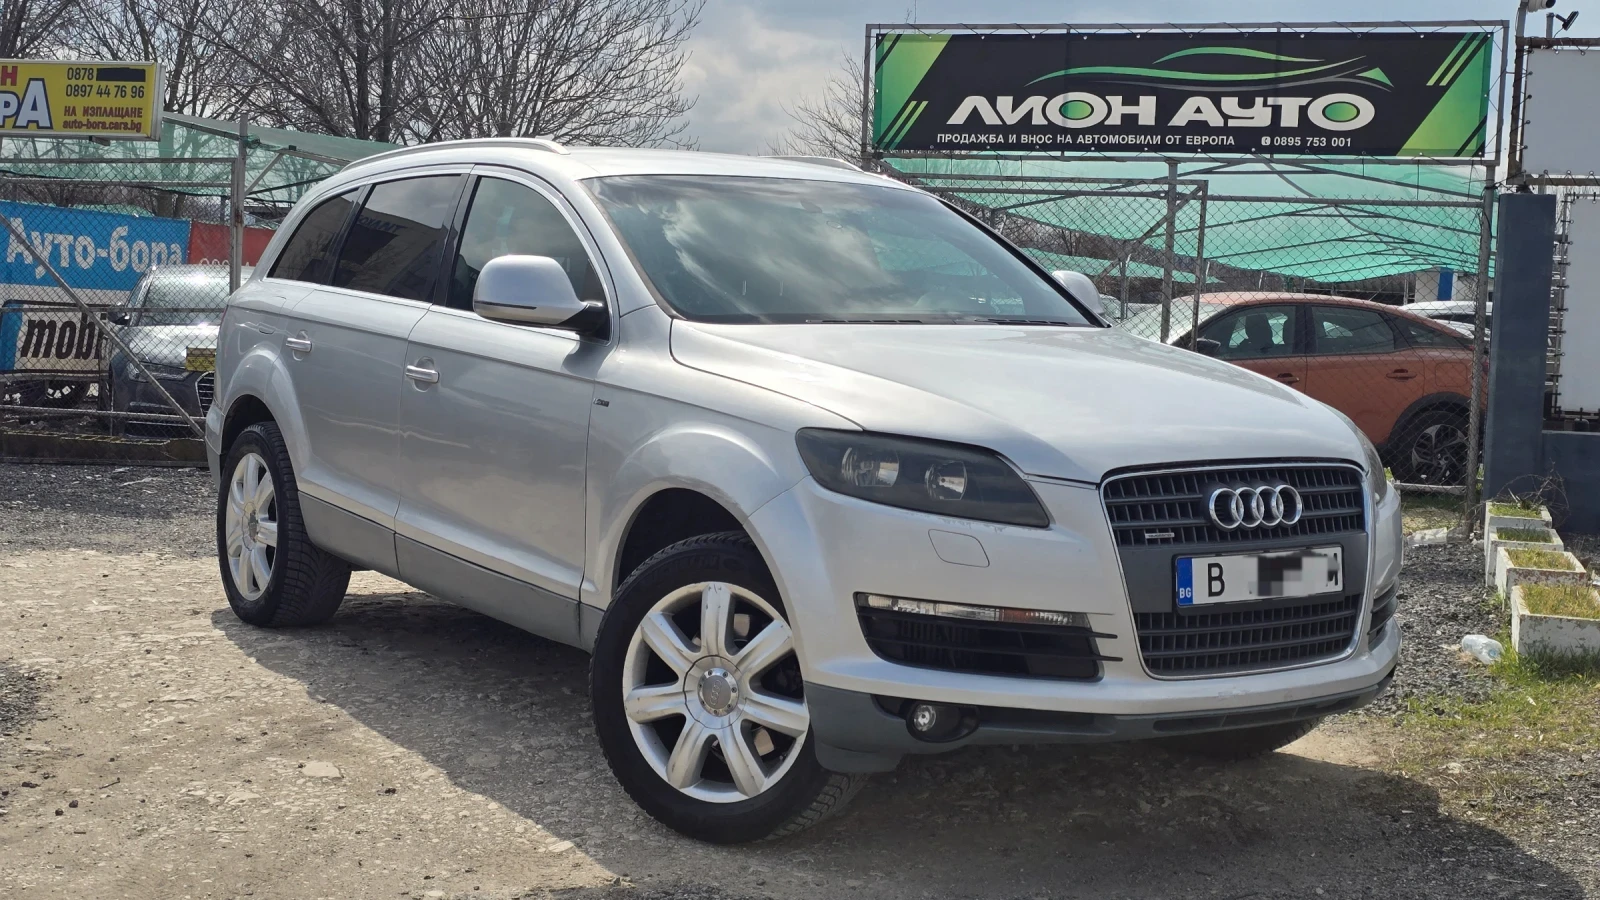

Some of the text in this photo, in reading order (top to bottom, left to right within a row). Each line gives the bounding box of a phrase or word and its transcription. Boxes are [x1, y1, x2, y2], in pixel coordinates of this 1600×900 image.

[67, 67, 94, 80] 0878
[65, 84, 145, 98] 0897 44 76 96
[64, 106, 143, 119] НА ИЗПЛАЩАНЕ
[946, 92, 1376, 131] ЛИОН АУТО
[62, 119, 142, 133] auto-bora.cars.bg
[936, 133, 1235, 146] ПРОДАЖБА И ВНОС НА АВТОМОБИЛИ ОТ ЕВРОПА
[1273, 136, 1351, 147] 0895 753 001
[1207, 562, 1226, 598] B
[1179, 587, 1192, 599] BG
